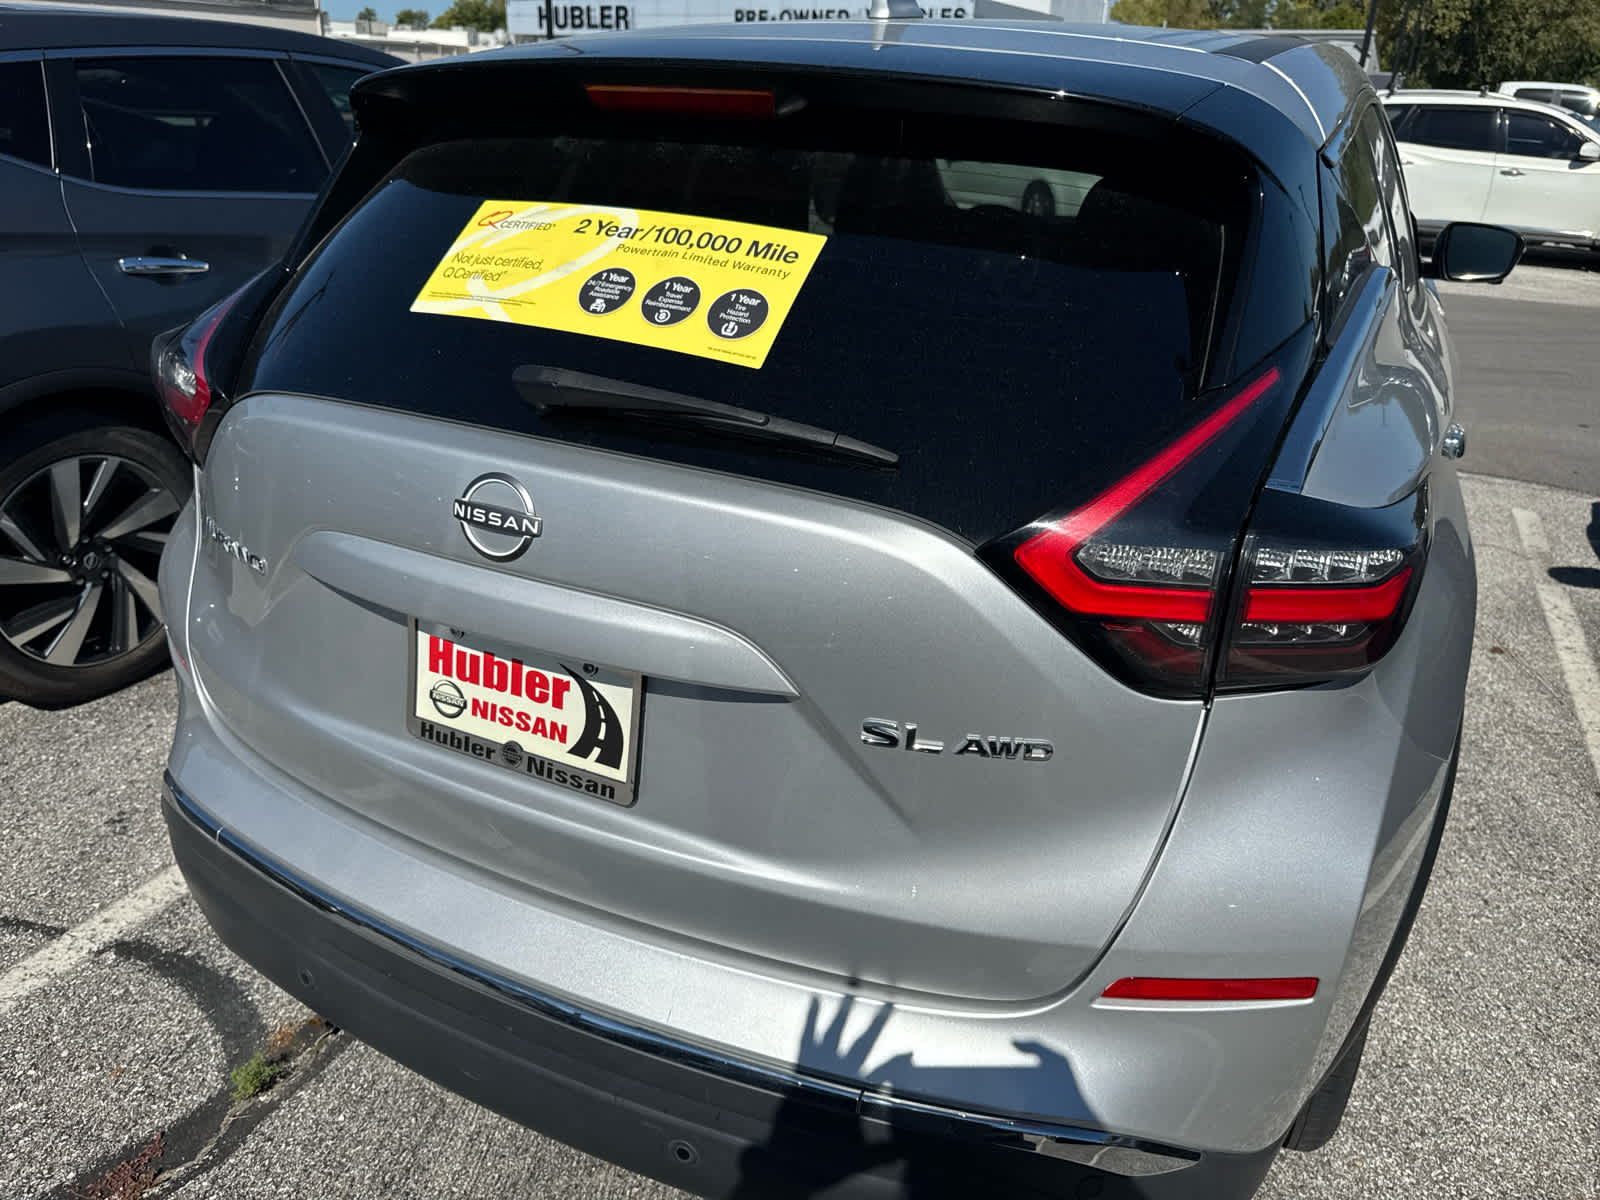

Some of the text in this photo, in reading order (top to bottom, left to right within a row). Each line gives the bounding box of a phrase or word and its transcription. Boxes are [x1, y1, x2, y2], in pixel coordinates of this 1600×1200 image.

[538, 5, 629, 30] HUBLER
[573, 219, 799, 264] 2 Year/100,000 Mile
[451, 252, 544, 272] Not just certified,
[616, 243, 791, 280] Powertrain Limited Warranty
[602, 272, 630, 283] 1 Year
[664, 281, 694, 293] 1 Year
[666, 291, 684, 299] Travel
[731, 293, 761, 306] 1 Year
[719, 312, 751, 324] Protection
[726, 308, 750, 317] Hazard
[735, 303, 747, 311] Tire
[454, 502, 539, 534] NISSAN
[428, 634, 571, 710] Hubler
[471, 697, 568, 745] NISSAN
[860, 717, 1055, 762] SL AWD
[420, 721, 616, 800] Hubler Nissan
